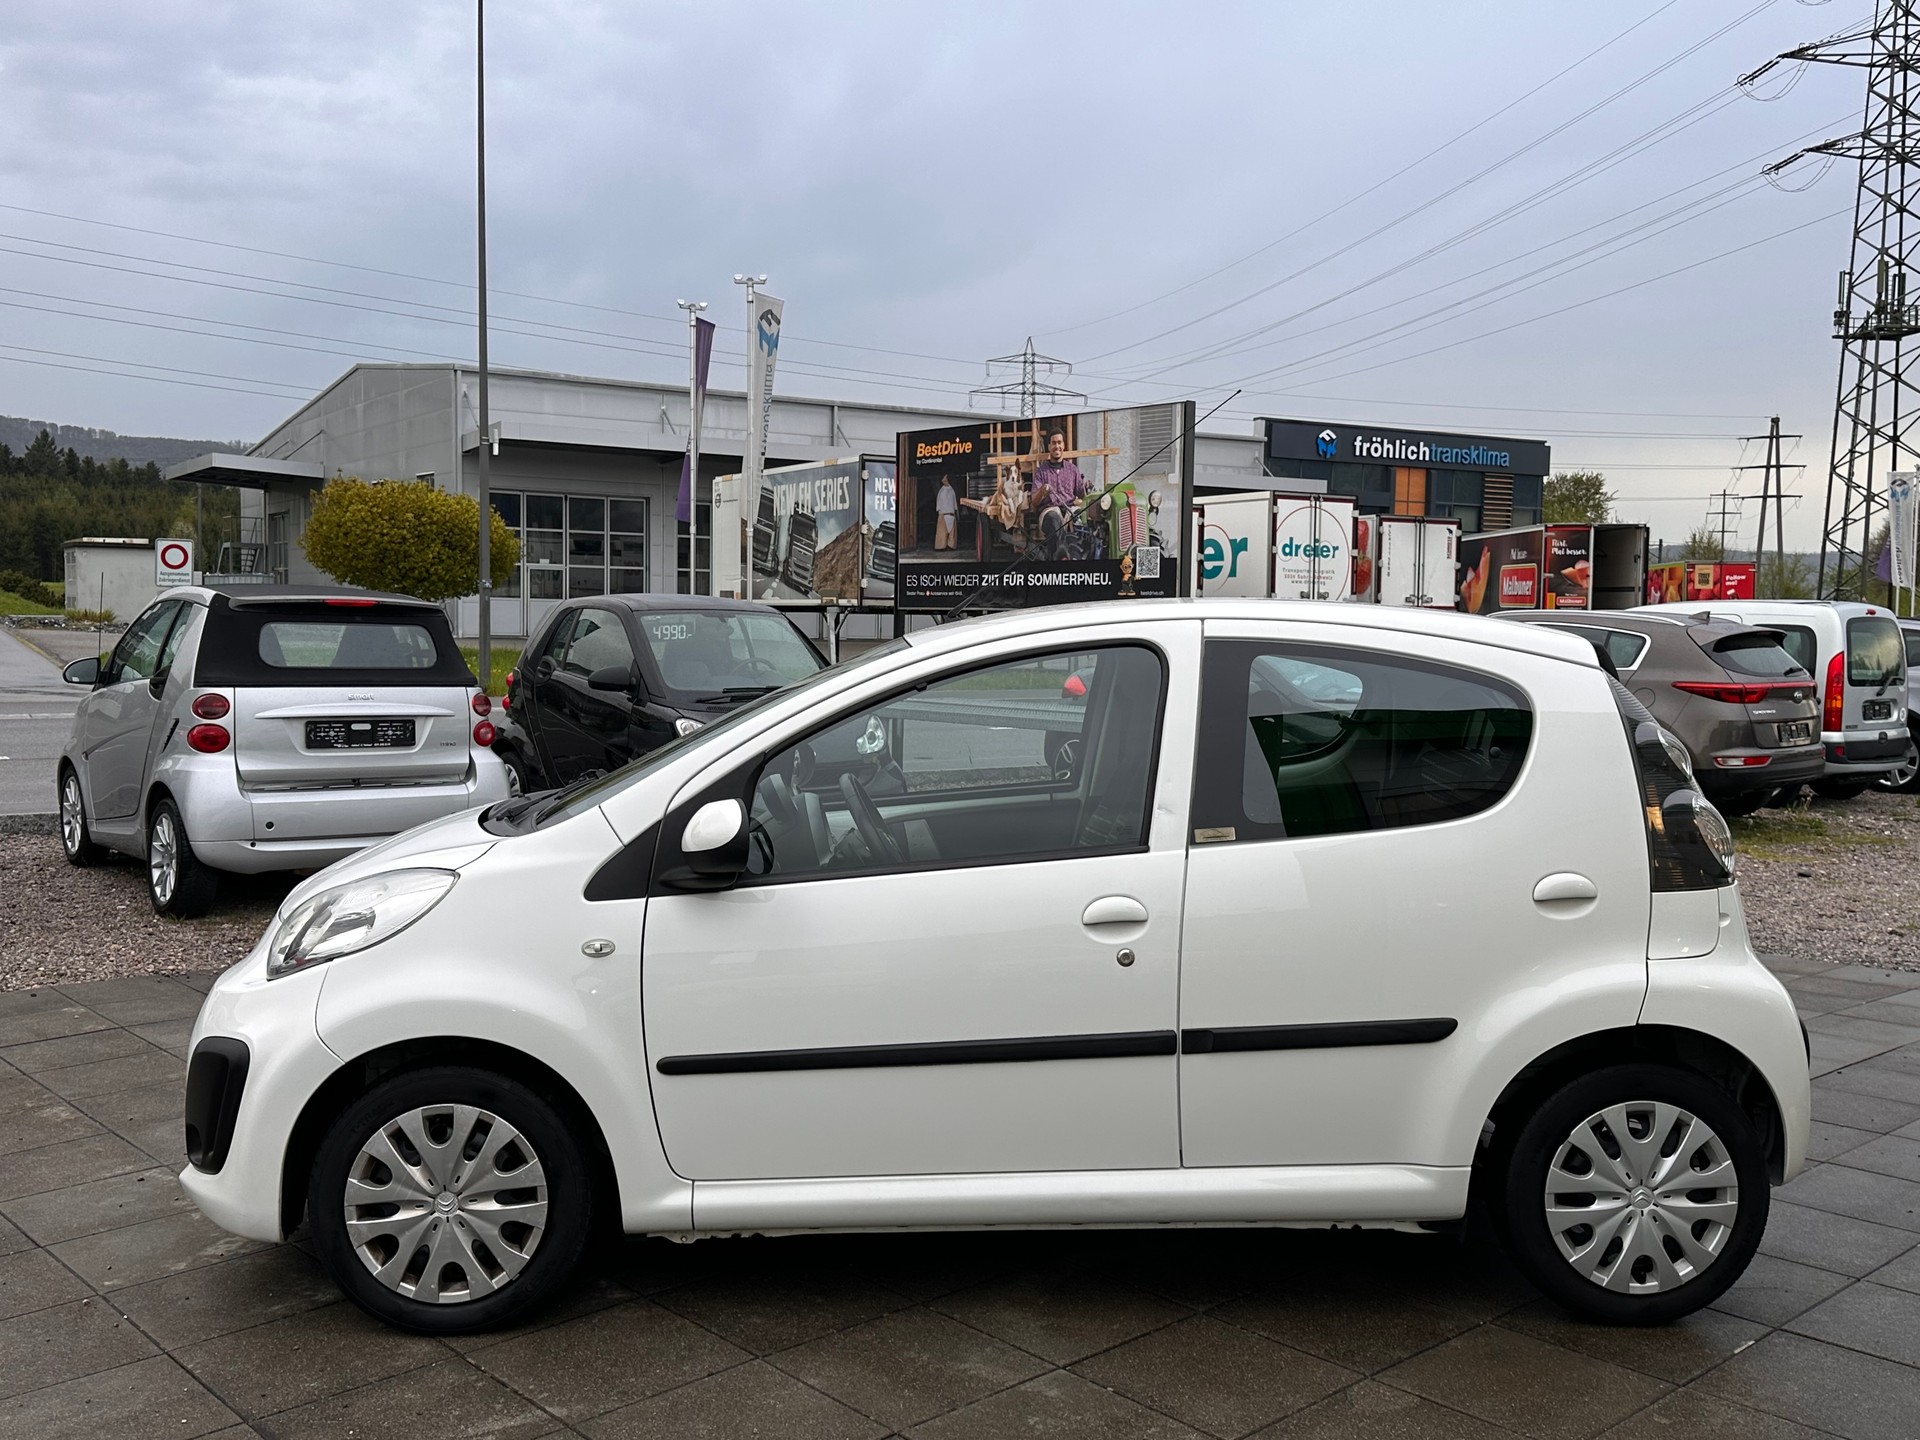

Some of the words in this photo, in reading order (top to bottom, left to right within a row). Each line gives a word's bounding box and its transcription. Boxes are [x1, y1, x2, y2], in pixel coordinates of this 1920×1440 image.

[916, 437, 972, 457] BestDrive
[773, 483, 796, 515] NEW
[799, 479, 812, 514] FH
[814, 476, 849, 513] SERIES
[874, 495, 887, 510] FH
[1282, 537, 1339, 558] dreier
[906, 575, 918, 586] ES
[920, 575, 941, 586] ISCH
[944, 574, 979, 586] WIEDER
[1003, 571, 1024, 586] FÜR
[1027, 573, 1112, 586] SOMMERPNEU.
[1503, 576, 1533, 596] Malbuner
[348, 692, 374, 701] smart
